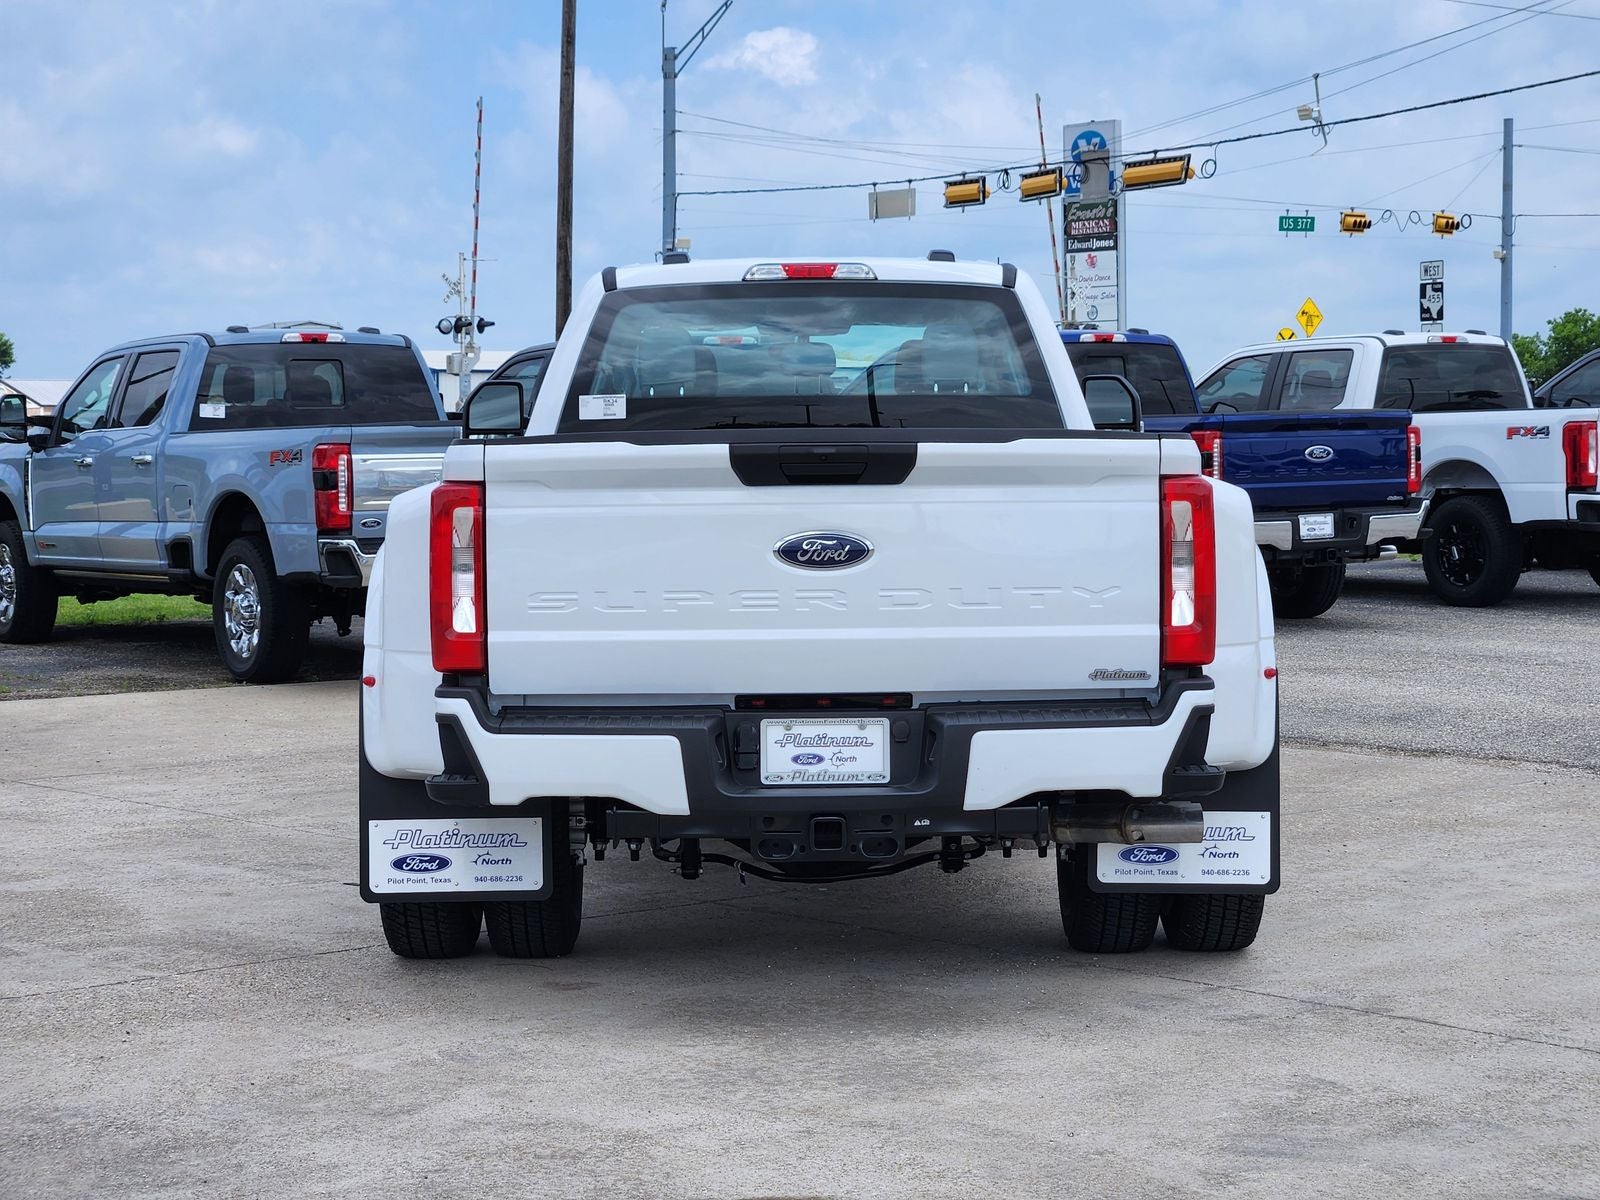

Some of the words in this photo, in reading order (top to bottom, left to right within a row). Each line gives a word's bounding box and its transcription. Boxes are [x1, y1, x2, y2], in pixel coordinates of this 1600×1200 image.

[1071, 218, 1110, 229] MEXICAN
[1282, 218, 1294, 229] US
[1297, 218, 1311, 229] 377
[1071, 226, 1111, 235] RESTAURANT
[1423, 265, 1440, 277] WEST
[1427, 294, 1441, 303] 455
[1506, 426, 1550, 440] FX4
[270, 449, 302, 466] FX4
[796, 539, 850, 562] Ford
[527, 588, 848, 613] SUPER
[878, 585, 1122, 610] DUTY
[1088, 668, 1151, 681] Platinum
[774, 732, 874, 748] Platinum
[835, 755, 857, 763] North
[791, 769, 864, 782] Platinum
[383, 828, 528, 849] Platinum
[1130, 848, 1166, 862] Ford
[1208, 851, 1240, 859] North
[402, 856, 439, 871] Ford
[481, 858, 512, 866] North
[1114, 868, 1132, 876] Pilot
[1134, 868, 1155, 876] Point,
[1157, 868, 1179, 876] Texas
[387, 877, 404, 885] Pilot
[406, 877, 428, 885] Point,
[430, 876, 452, 884] Texas
[474, 875, 524, 883] 940-686-2236
